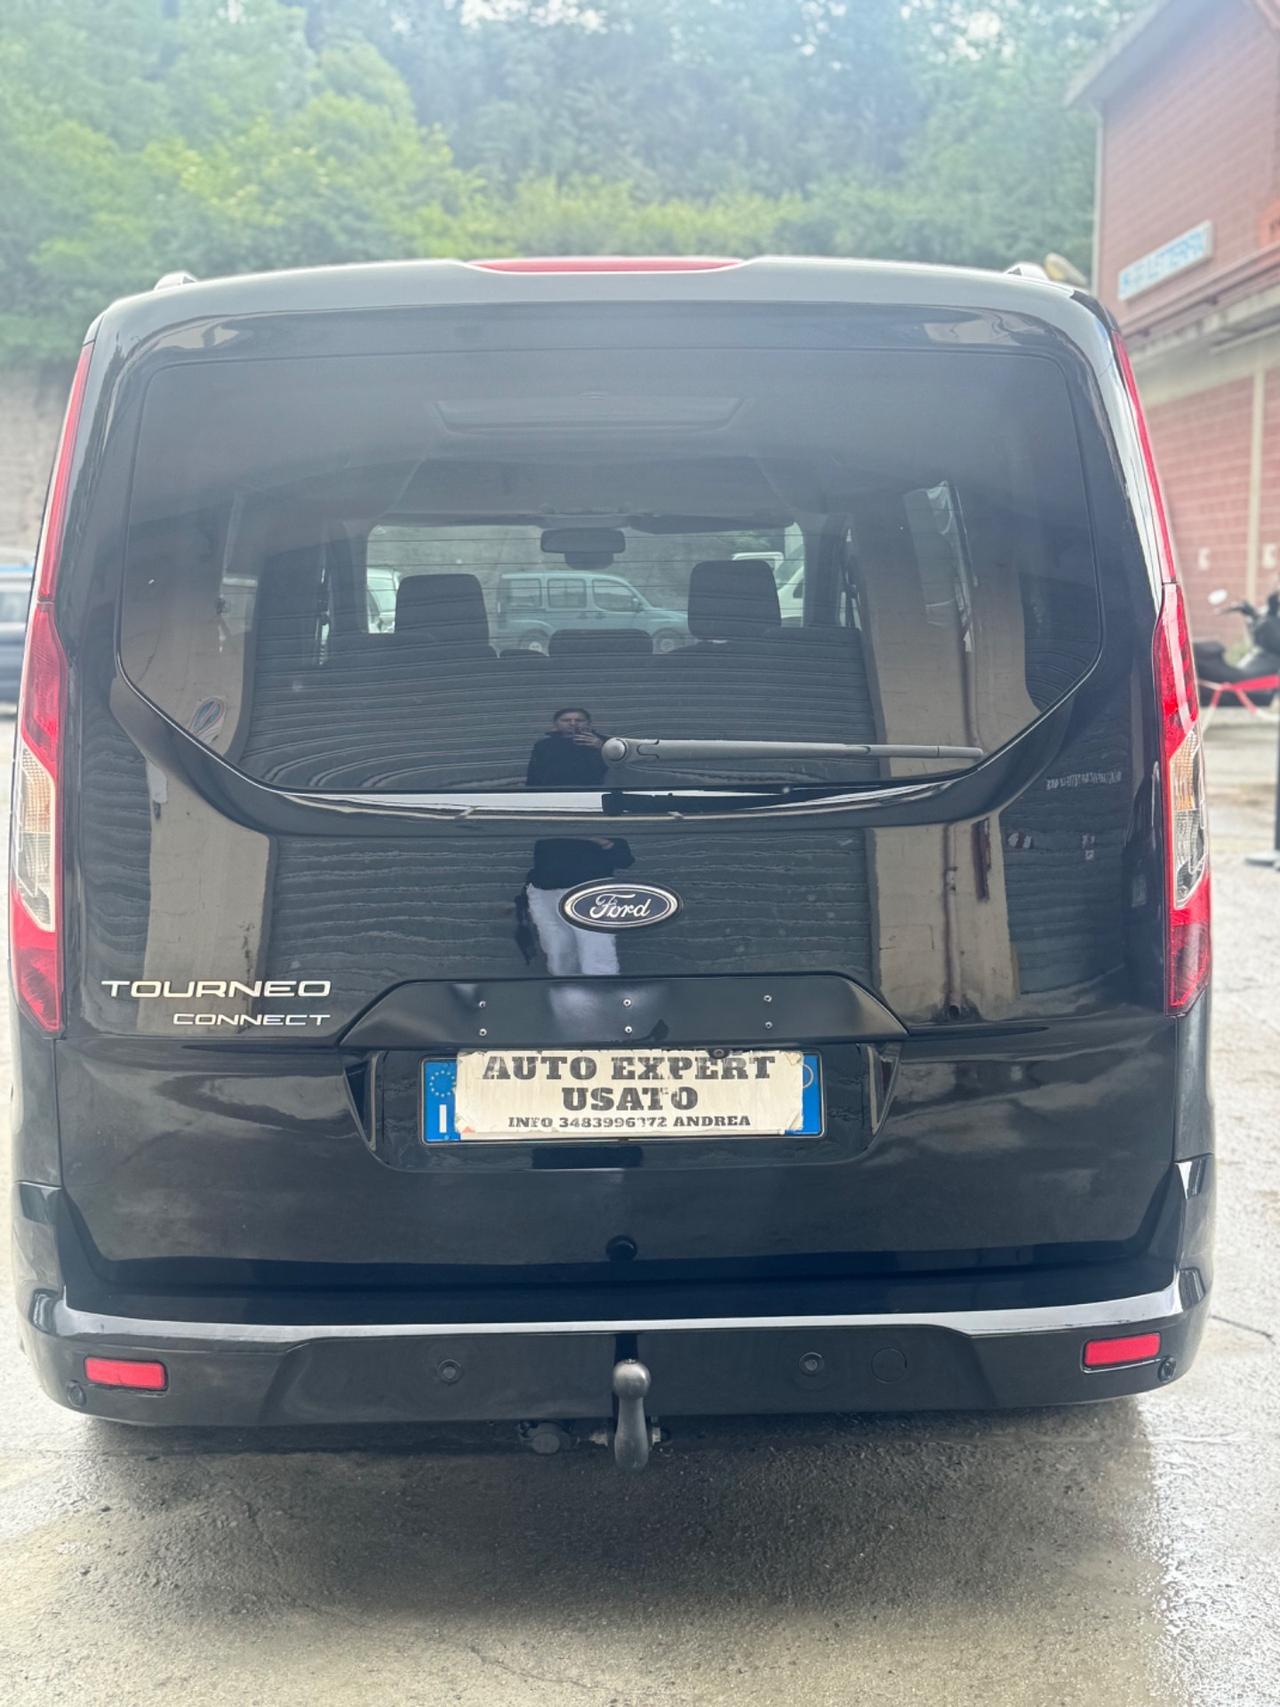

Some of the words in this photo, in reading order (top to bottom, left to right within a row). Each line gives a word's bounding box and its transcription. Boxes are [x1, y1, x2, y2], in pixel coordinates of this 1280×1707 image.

[589, 893, 651, 919] Ford
[101, 980, 331, 998] TOURNEO
[173, 1013, 331, 1026] CONNECT
[482, 1056, 597, 1080] AUTO
[611, 1055, 775, 1080] EXPERT
[562, 1086, 698, 1111] USATO
[439, 1104, 447, 1133] I
[508, 1117, 553, 1128] INFO
[673, 1115, 750, 1127] ANDREA
